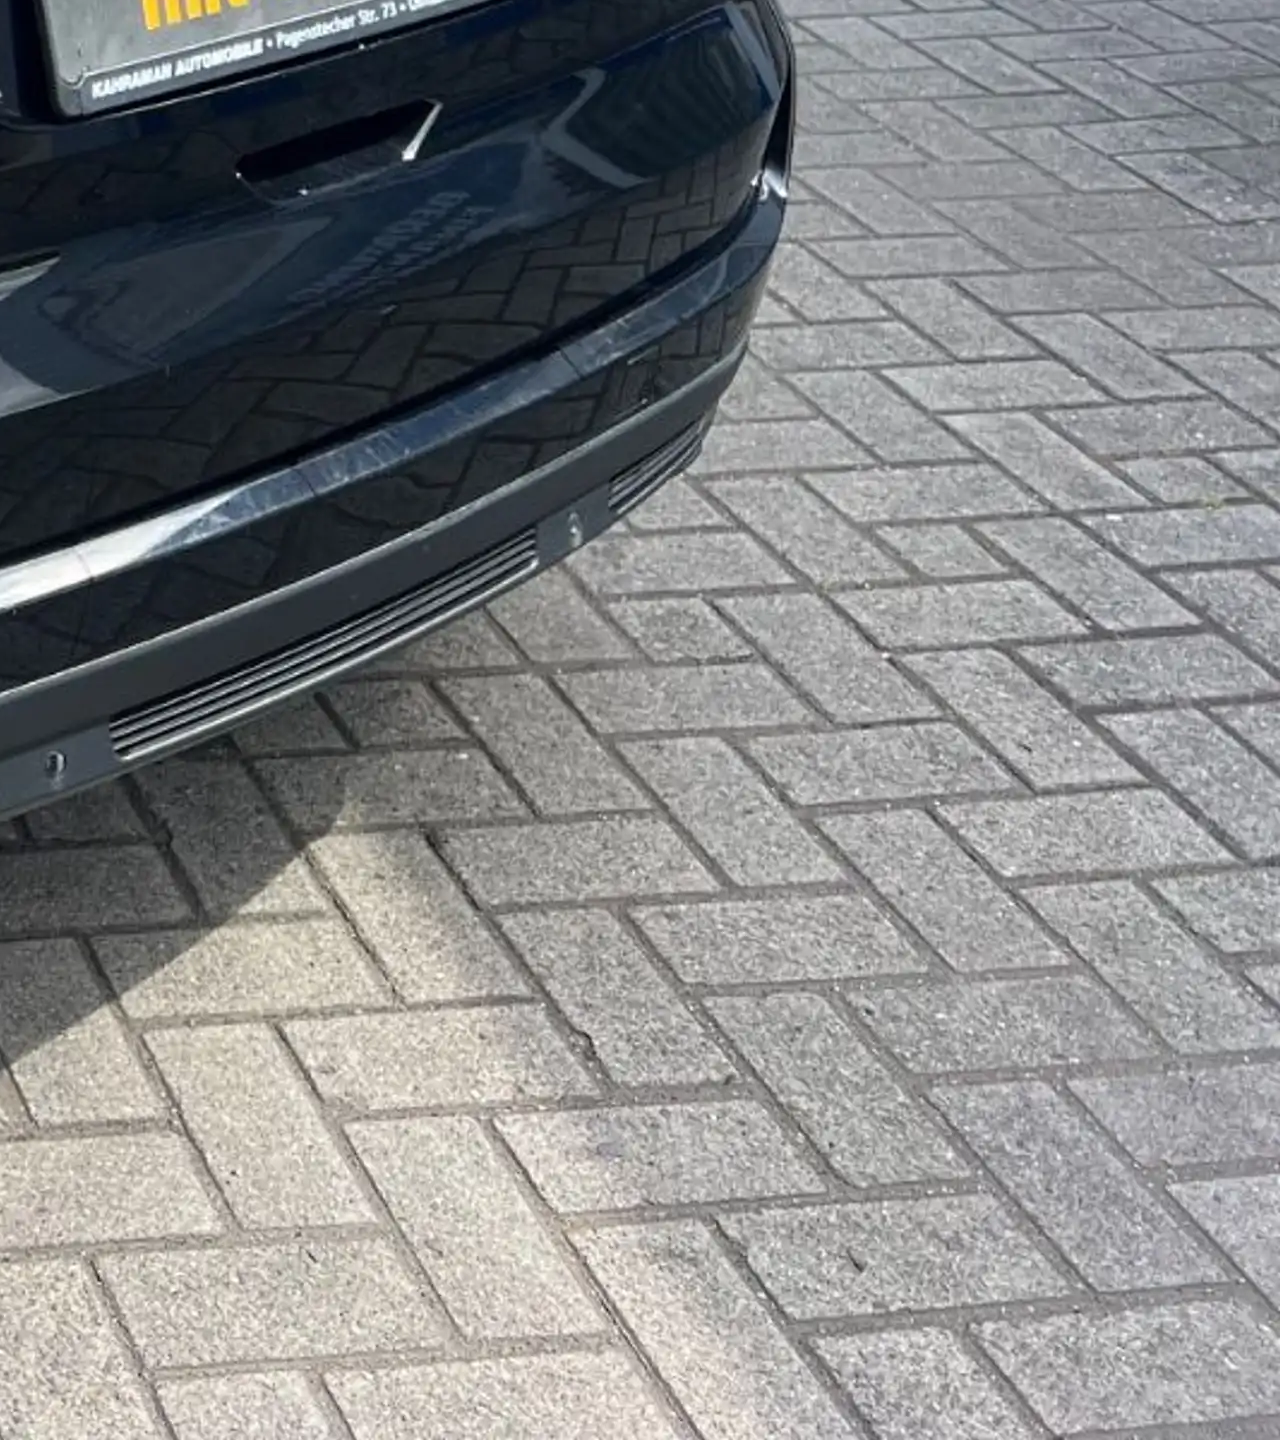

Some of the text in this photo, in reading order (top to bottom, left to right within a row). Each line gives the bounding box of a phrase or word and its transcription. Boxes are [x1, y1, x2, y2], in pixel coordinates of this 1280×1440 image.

[91, 63, 173, 99] KAHRAMAN
[175, 37, 265, 76] AUTOMOBILE
[276, 13, 356, 49] Pagenstecher
[358, 9, 379, 26] Str.
[382, 1, 397, 19] 73
